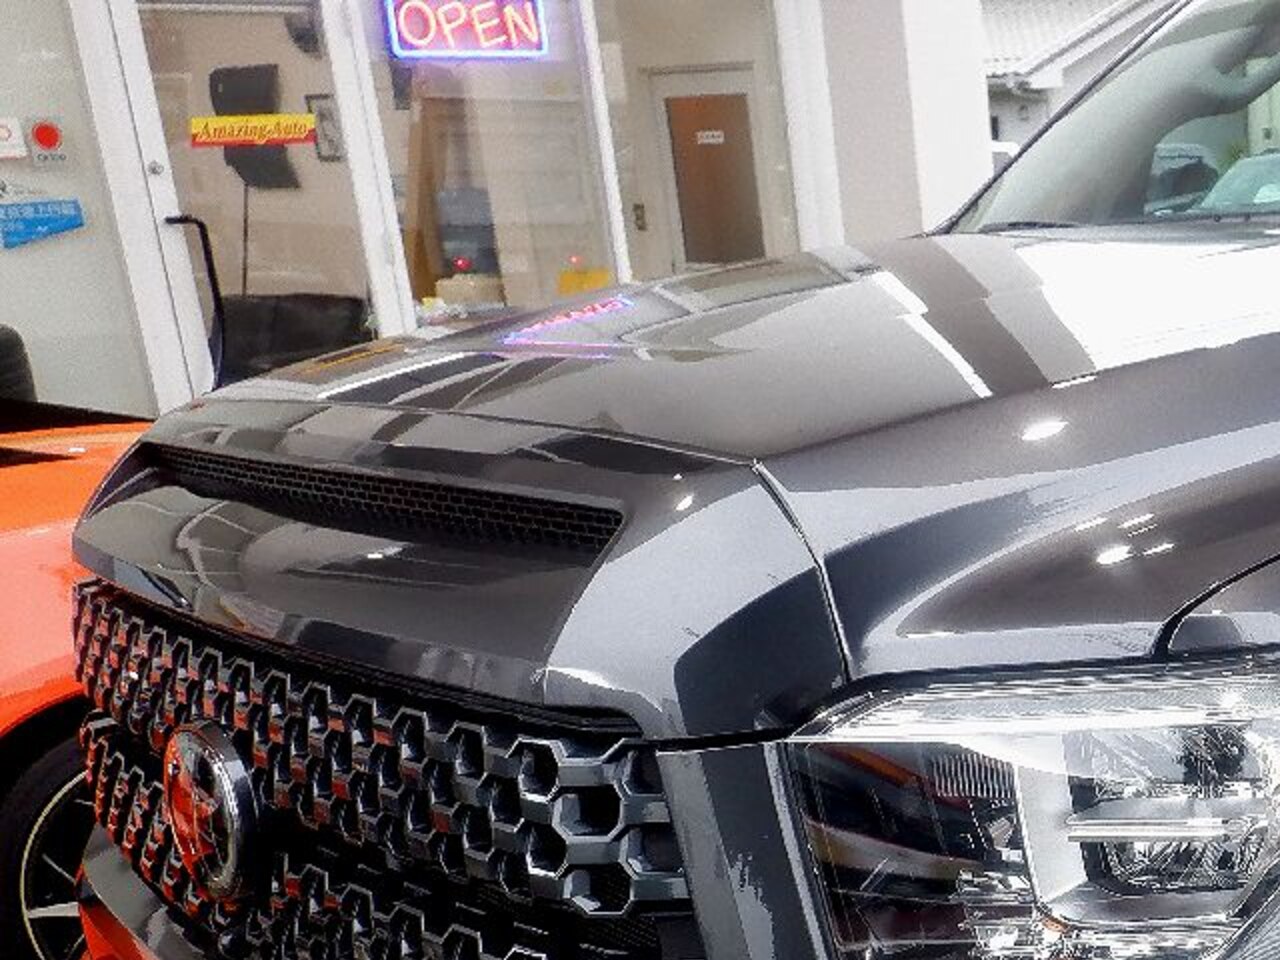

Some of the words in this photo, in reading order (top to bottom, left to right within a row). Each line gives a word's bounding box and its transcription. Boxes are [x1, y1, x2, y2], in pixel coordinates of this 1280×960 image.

[397, 1, 539, 48] OPEN
[199, 120, 265, 141] Amazing
[269, 120, 307, 137] Auto
